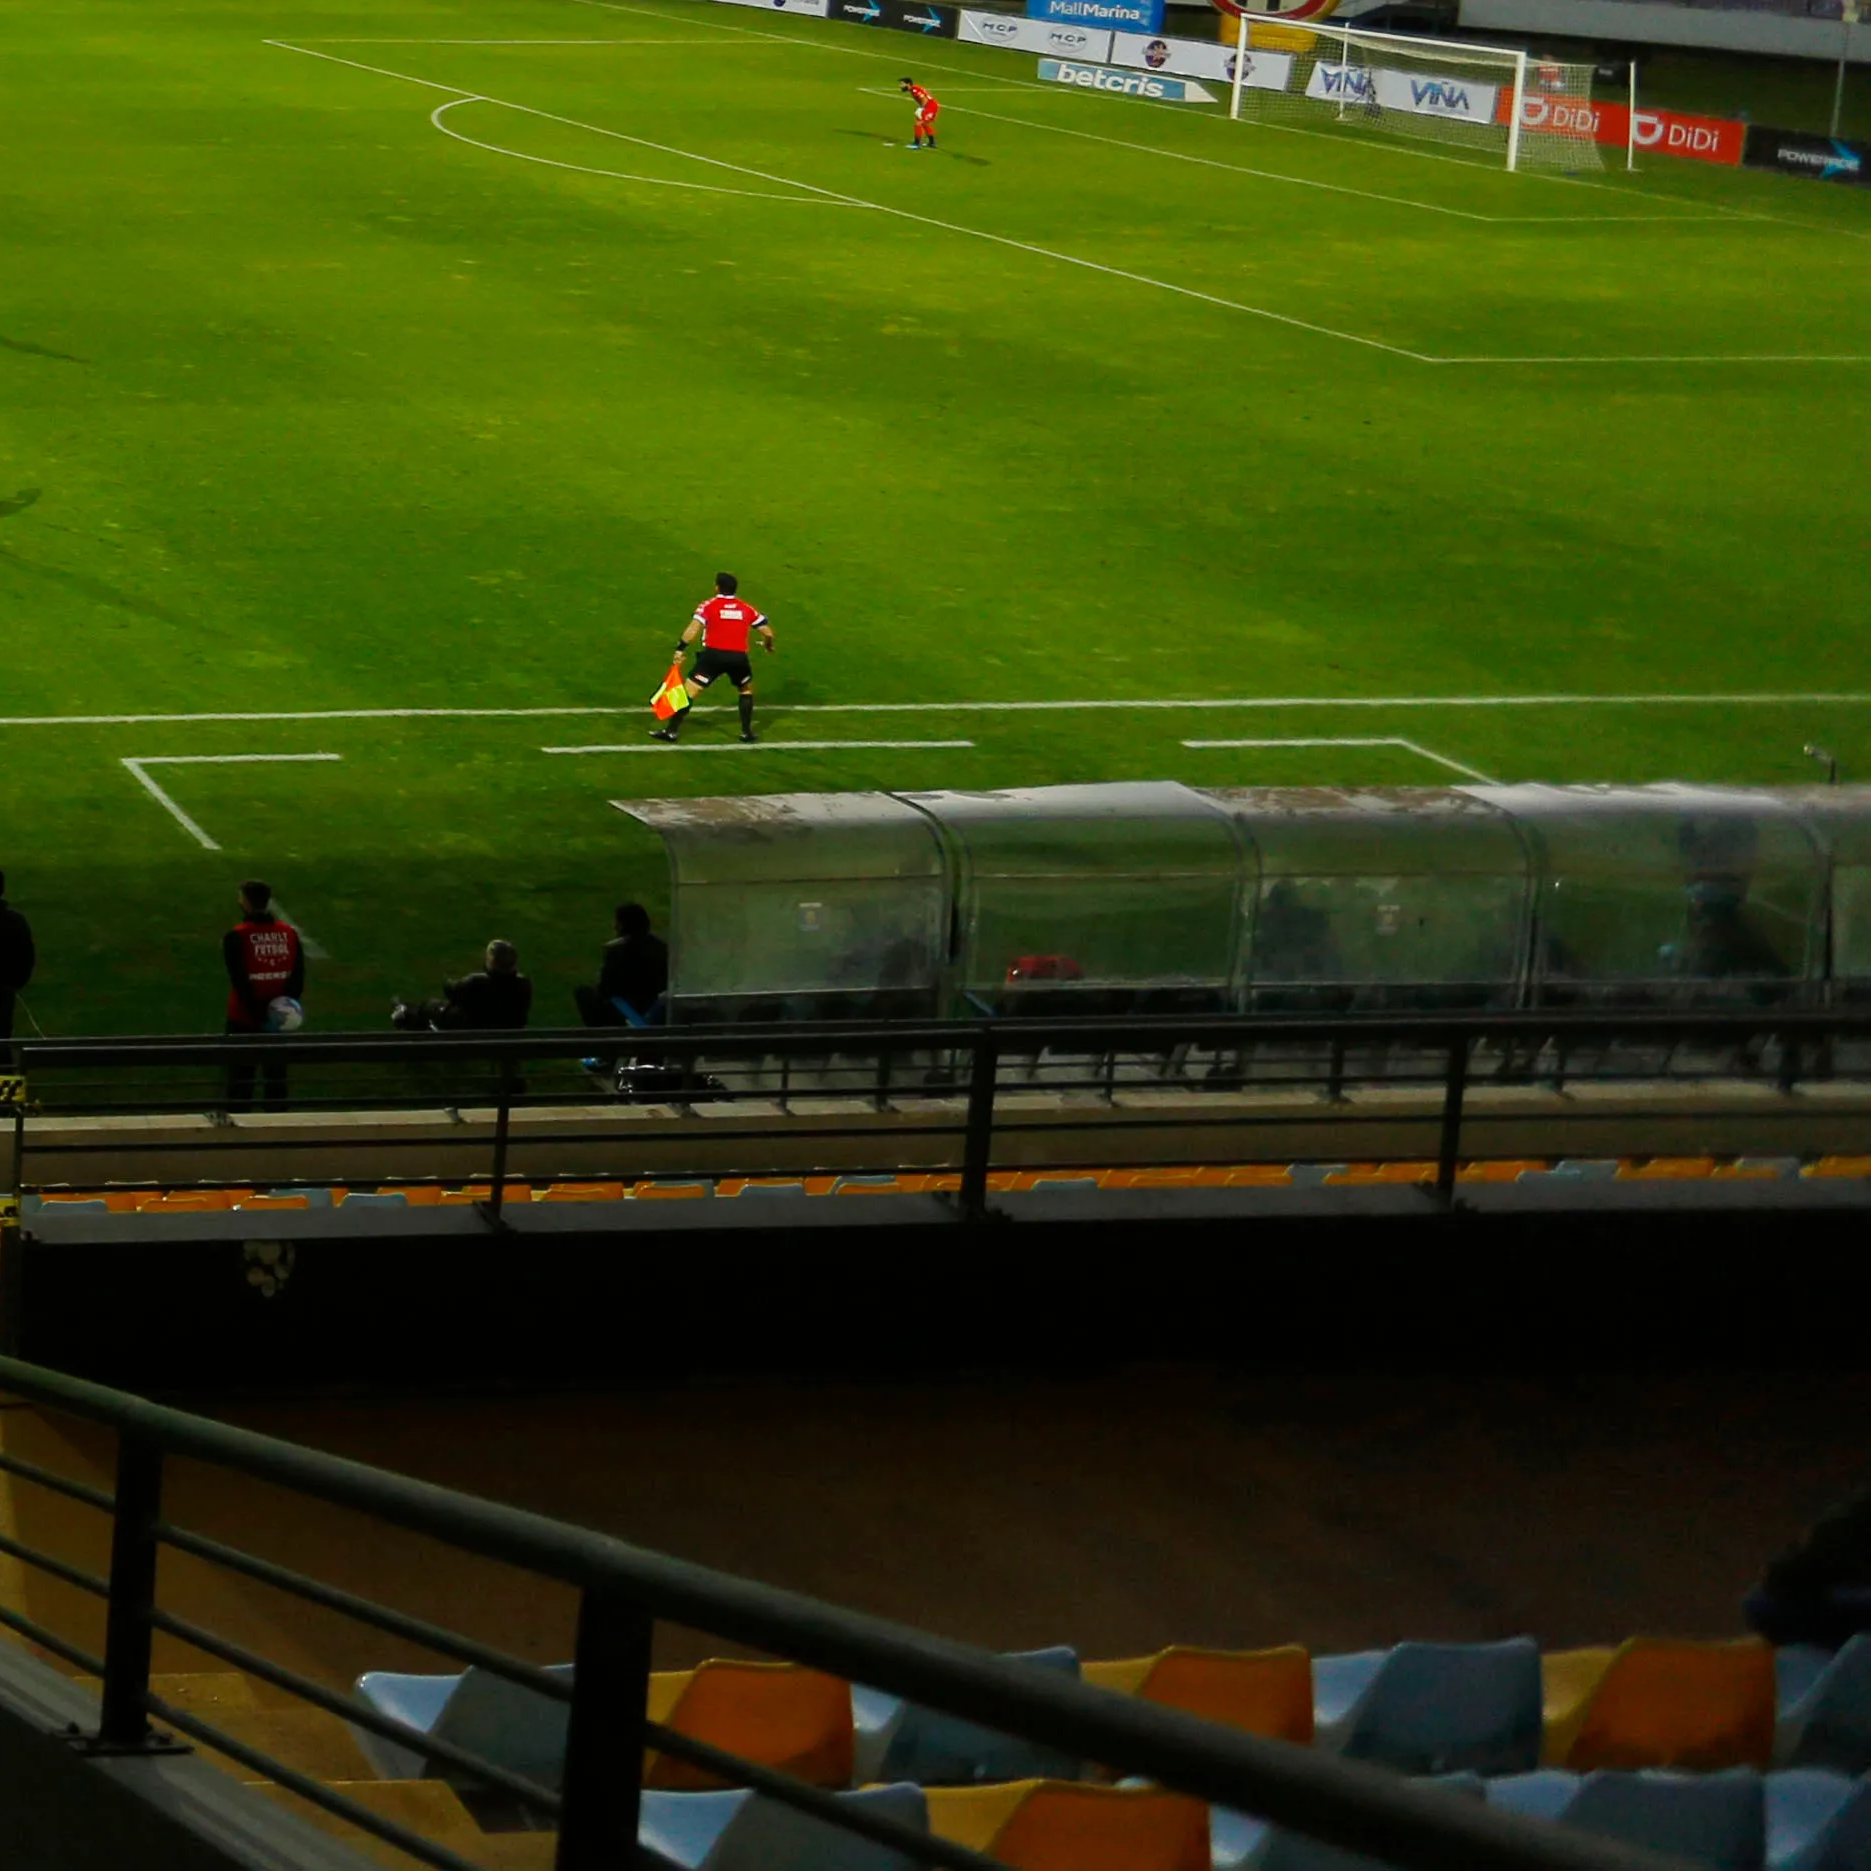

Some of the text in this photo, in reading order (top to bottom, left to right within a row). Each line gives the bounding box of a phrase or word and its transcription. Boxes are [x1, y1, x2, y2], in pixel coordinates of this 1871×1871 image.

[1049, 0, 1140, 21] MallMarina
[982, 22, 1018, 35] MCP
[1049, 32, 1088, 44] MCP
[1057, 64, 1164, 98] betcris
[1320, 66, 1375, 98] VIÑA
[1410, 79, 1470, 110] VIÑA
[1553, 104, 1600, 133] DiDi
[1668, 123, 1720, 152] DiDi
